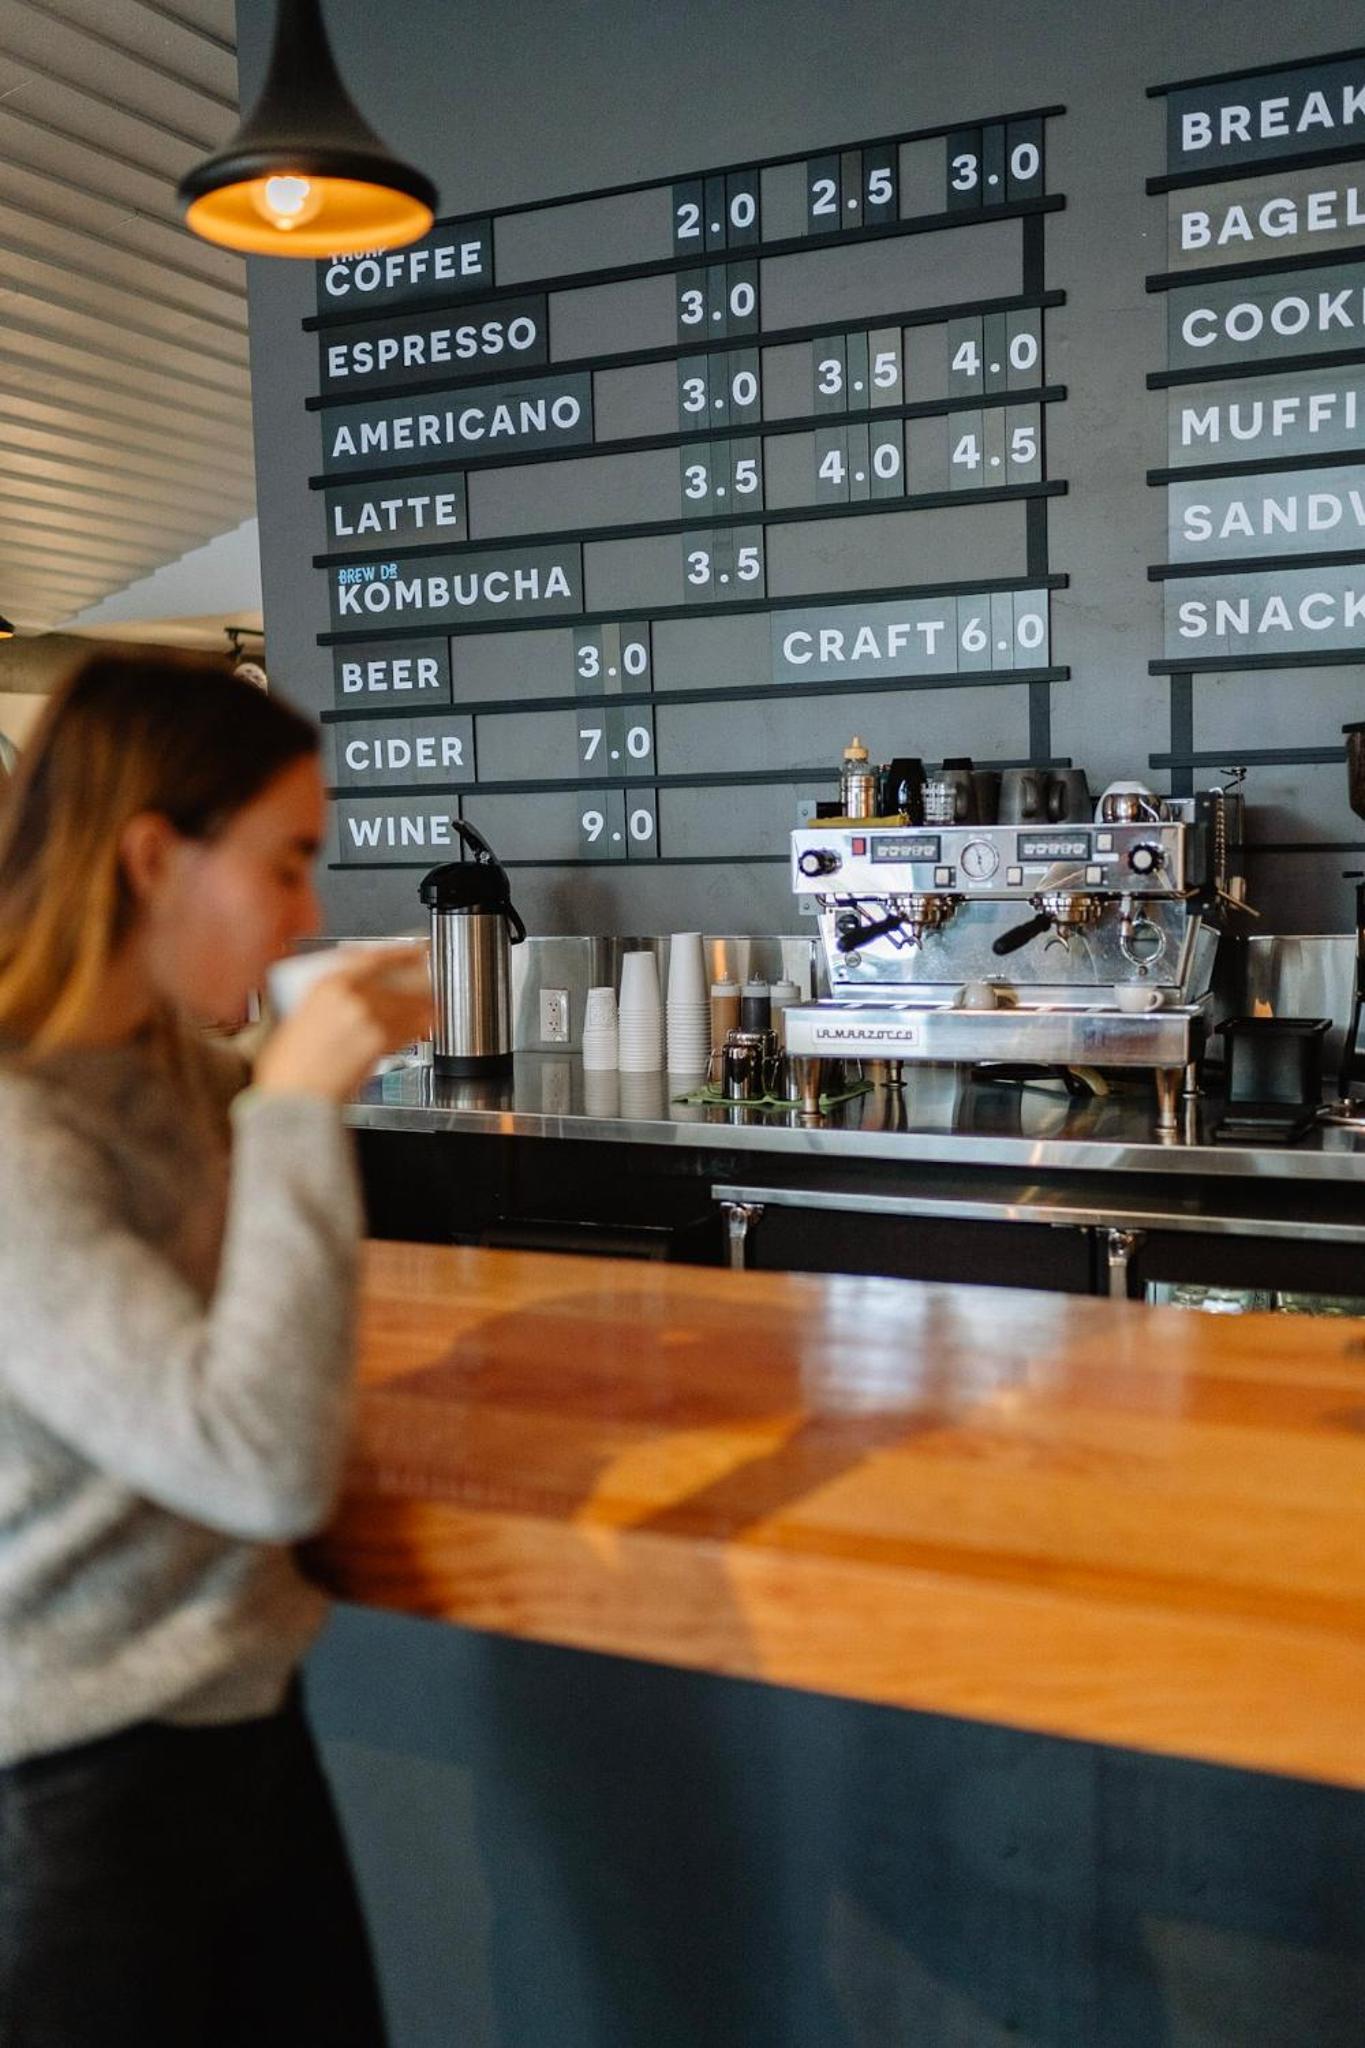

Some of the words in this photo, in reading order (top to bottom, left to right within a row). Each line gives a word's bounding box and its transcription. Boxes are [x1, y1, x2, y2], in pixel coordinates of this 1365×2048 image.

[1182, 85, 1365, 151] BREAK
[325, 241, 482, 296] COFFEE
[677, 193, 755, 238] 2.0
[812, 168, 893, 215] 2.5
[951, 143, 1039, 190] 3.0
[1181, 188, 1365, 249] BAGEL
[328, 317, 536, 377] ESPRESSO
[680, 283, 755, 324] 3.0
[1182, 289, 1365, 347] COOK
[333, 396, 580, 456] AMERICANO
[683, 372, 757, 412] 3.0
[818, 352, 897, 394] 3.5
[952, 334, 1037, 375] 4.0
[1182, 391, 1356, 445] MUFFI
[334, 494, 456, 536] LATTE
[685, 460, 758, 499] 3.5
[819, 444, 900, 484] 4.0
[952, 427, 1036, 469] 4.5
[338, 567, 375, 584] BREW
[338, 566, 571, 615] KOMBUCHA
[688, 547, 760, 584] 3.5
[1178, 591, 1365, 637] SNACK
[342, 658, 439, 693] BEER
[578, 643, 647, 678] 3.0
[783, 621, 944, 664] CRAFT
[961, 614, 1044, 652] 6.0
[345, 736, 464, 770] CIDER
[580, 727, 650, 760] 7.0
[349, 816, 450, 847] WINE
[582, 810, 653, 842] 9.0
